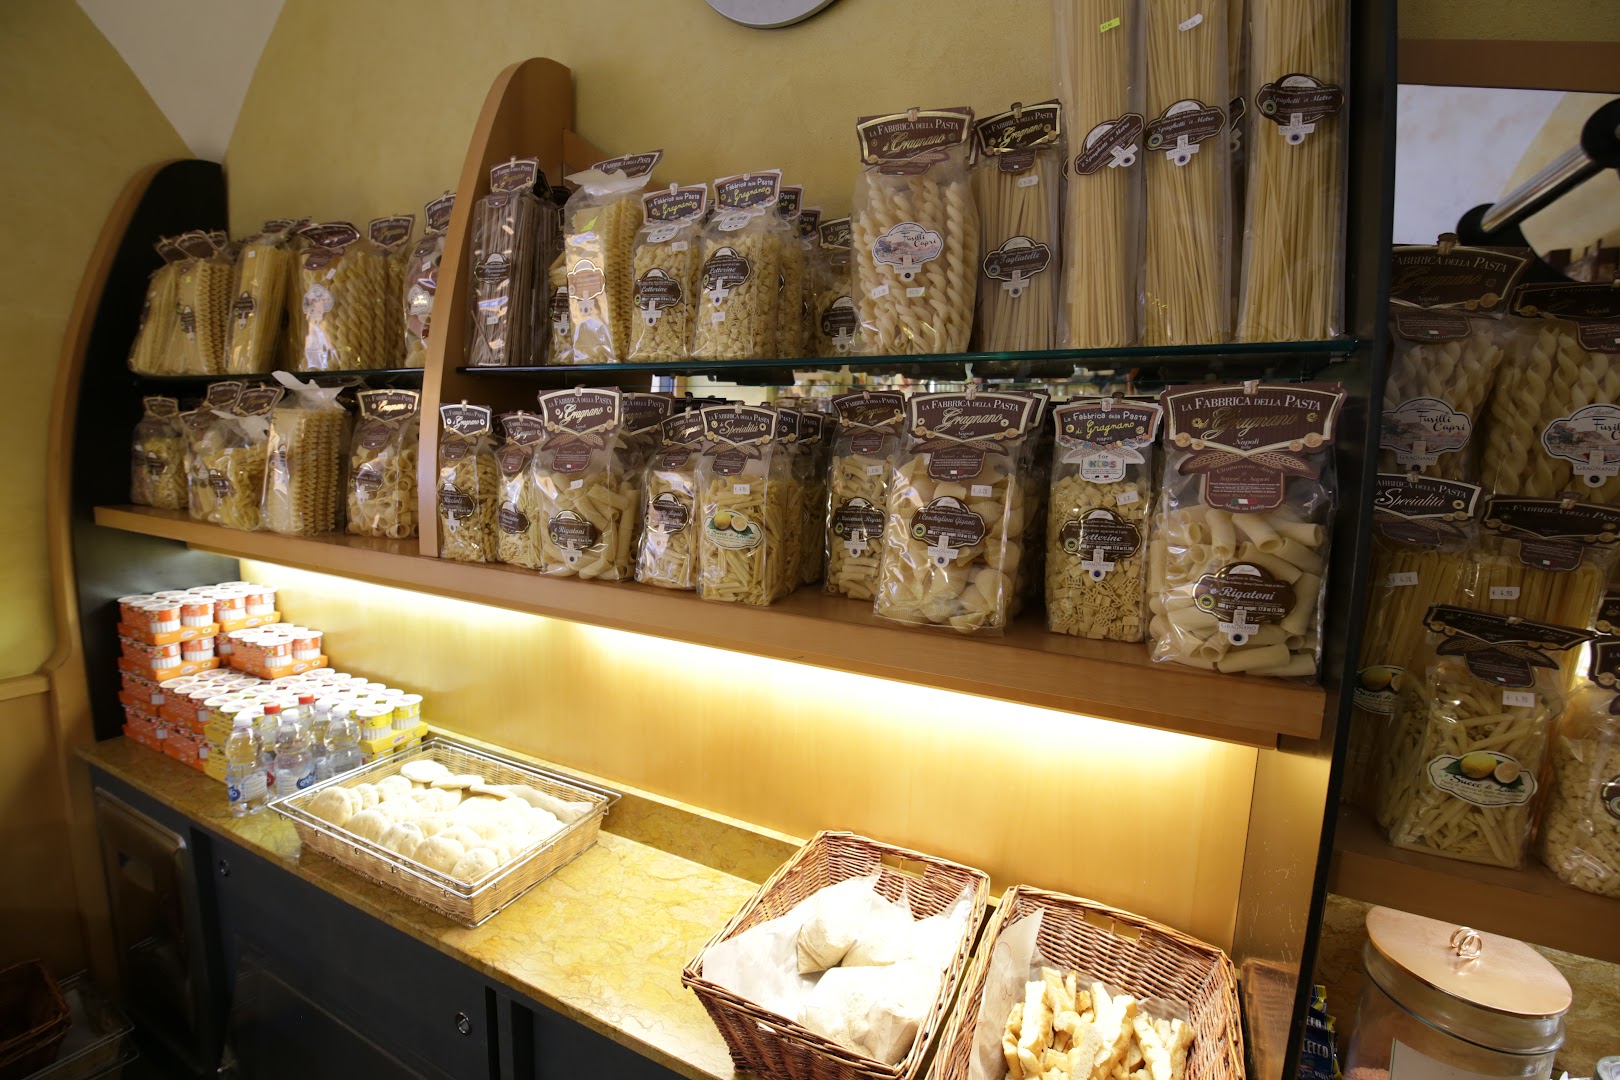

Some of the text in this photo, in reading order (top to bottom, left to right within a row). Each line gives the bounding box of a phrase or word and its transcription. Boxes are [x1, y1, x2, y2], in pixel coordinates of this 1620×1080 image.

[1272, 94, 1333, 105] Spaghetti Metro
[991, 118, 1020, 132] FABBRICA
[1034, 111, 1054, 121] PASTA
[1157, 115, 1215, 136] Spaghetti Metro
[869, 118, 959, 138] LA FABBRICA DELLA PASTA
[999, 123, 1043, 148] Gragnano
[725, 182, 747, 191] Fabbrica
[757, 178, 774, 186] Pasta
[653, 194, 674, 205] Fabbrica
[684, 192, 700, 201] Pasta
[734, 187, 765, 205] Gragnano
[780, 192, 796, 200] Pasta
[661, 201, 693, 218] Gragnano
[900, 232, 926, 242] Fusilli
[913, 237, 938, 248] Capri
[999, 251, 1041, 265] Tagliatelle
[1443, 258, 1466, 267] DELLA
[1472, 256, 1508, 273] PASTA
[640, 285, 669, 293] Letterine
[1418, 295, 1441, 303] Napoli
[554, 397, 581, 406] FABBRICA
[594, 395, 613, 406] PASTA
[648, 398, 665, 409] PASTA
[845, 400, 870, 409] FABBRICA
[931, 399, 971, 410] FABBRICA
[992, 399, 1019, 411] PASTA
[1181, 395, 1321, 412] LA FABBRICA DELLA PASTA
[475, 411, 486, 419] PASTA
[559, 403, 604, 425] Gragnano
[714, 412, 740, 421] FABBRICA
[753, 413, 770, 423] PASTA
[780, 414, 794, 423] PASTA
[1073, 412, 1106, 421] Fabbrica
[1123, 411, 1148, 422] Pasta
[1416, 410, 1451, 424] Fusilli
[454, 415, 480, 430] Gragnano
[670, 419, 688, 428] FABBRICA
[803, 417, 817, 426] PASTA
[933, 408, 1003, 432] Gragnano
[1201, 407, 1298, 440] Gragnano
[719, 419, 758, 437] Specialità
[1086, 420, 1135, 439] Gragnano
[1432, 423, 1465, 433] Capri
[1233, 438, 1260, 446] Napoli
[1089, 460, 1117, 469] KIDS
[1215, 464, 1256, 474] Cinquecento
[1376, 479, 1468, 499] ABBRICA DELLA PASTA
[1374, 488, 1446, 508] Specialità
[1513, 505, 1563, 514] FABBRICA
[922, 514, 977, 526] Conchiglioni Giganti
[558, 526, 586, 535] Rigatoni
[1080, 533, 1122, 542] Letterine
[1218, 587, 1276, 601] Rigatoni
[1221, 623, 1257, 631] GRAGNANO
[1356, 688, 1382, 699] Succo
[1450, 774, 1481, 788] Succo
